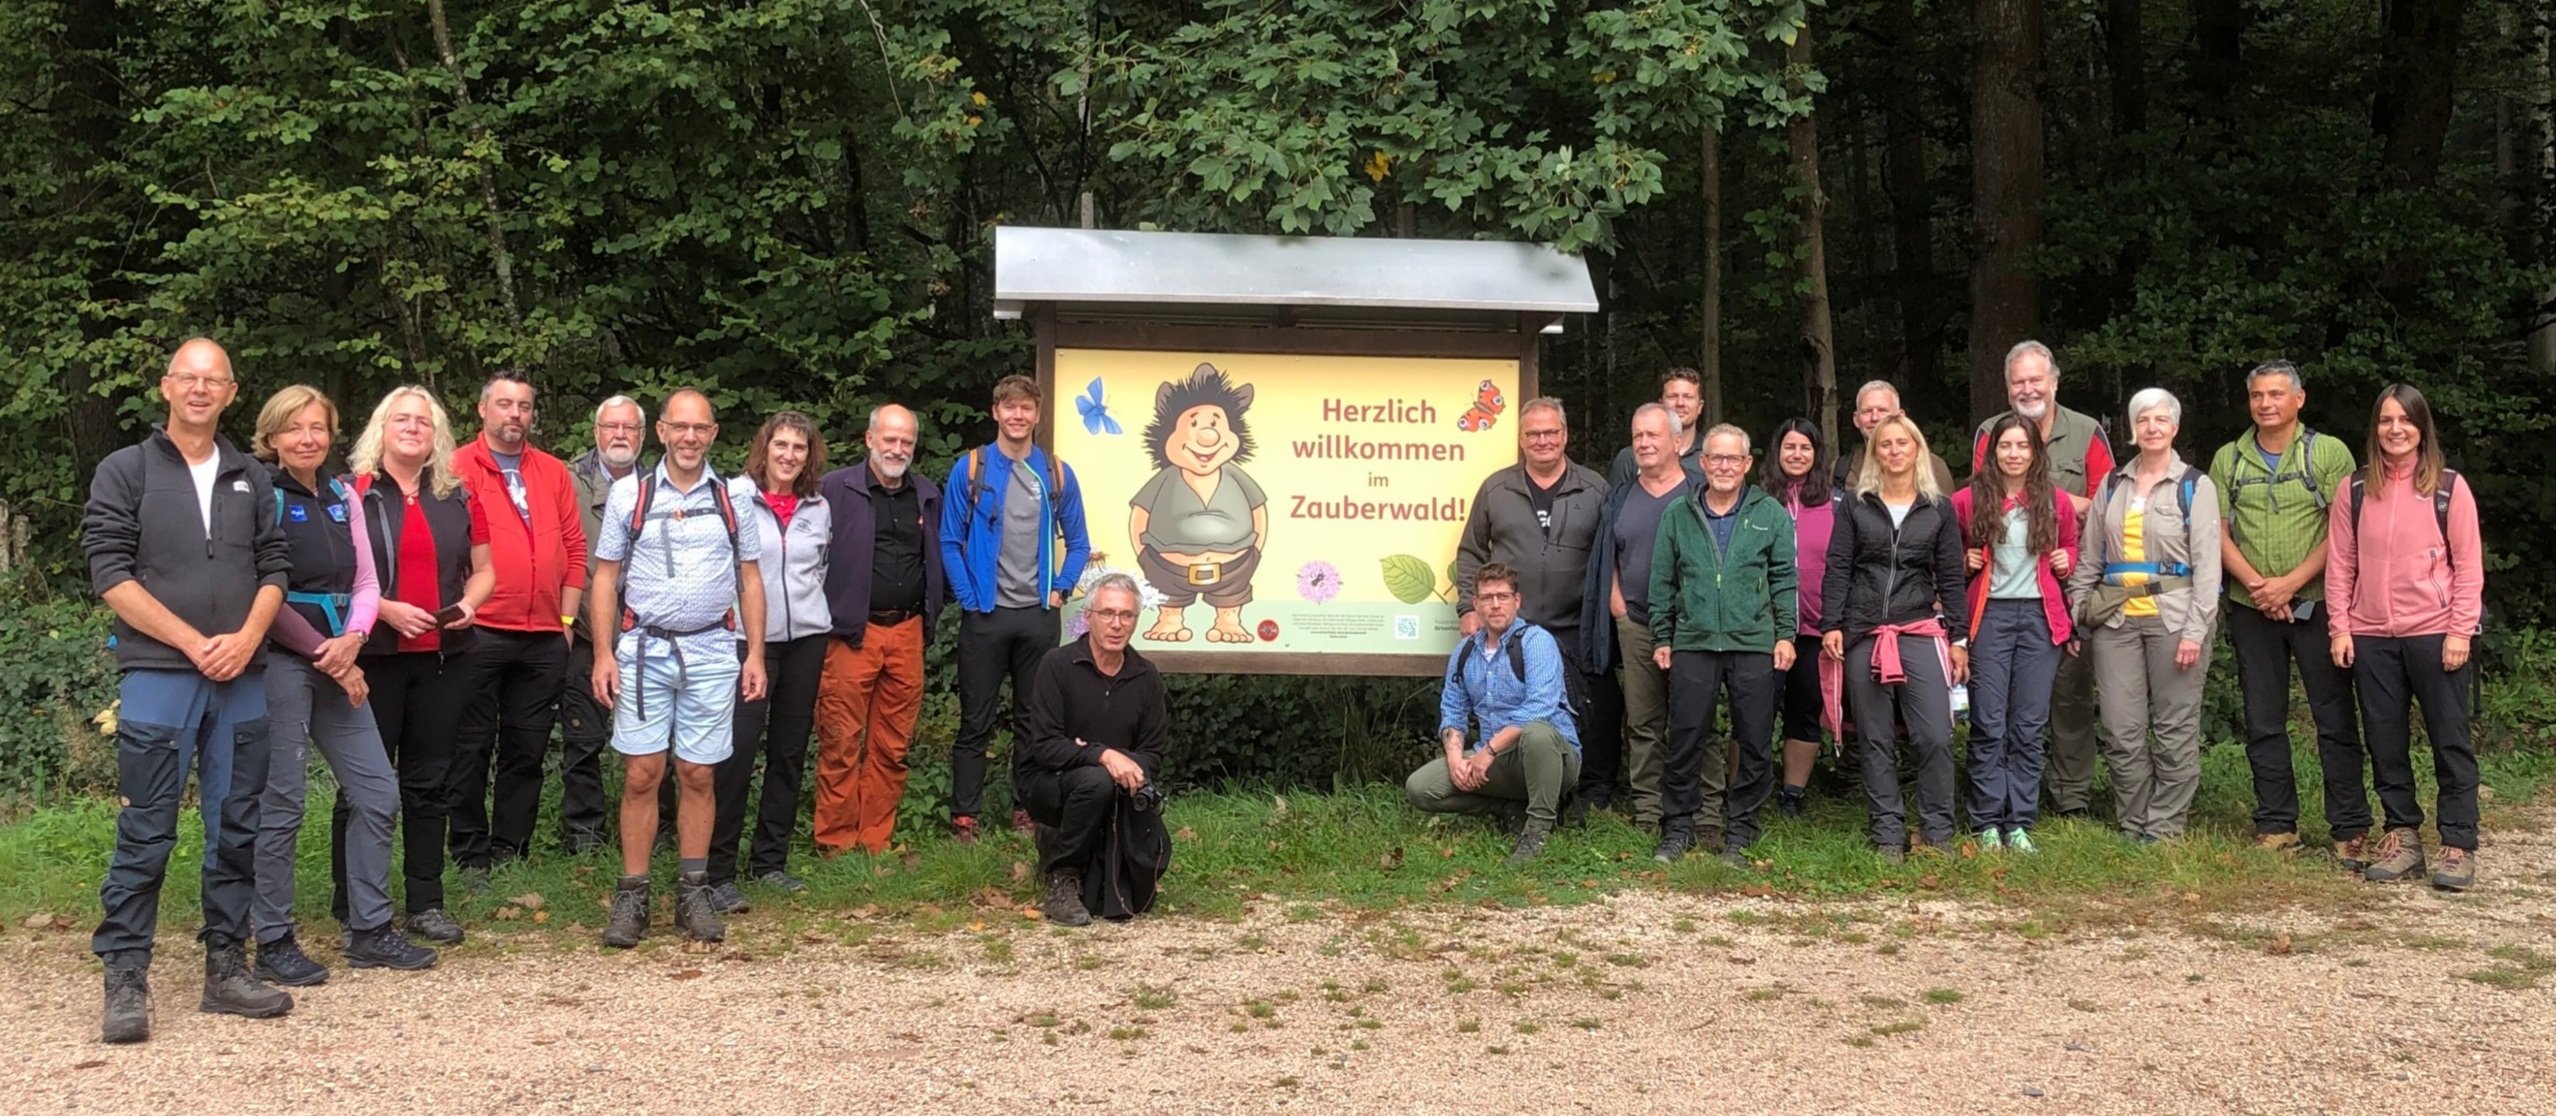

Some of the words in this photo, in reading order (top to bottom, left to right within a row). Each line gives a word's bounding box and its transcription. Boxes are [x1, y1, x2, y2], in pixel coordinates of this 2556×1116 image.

[1323, 398, 1436, 424] Herzlich
[1292, 434, 1465, 461] willkommen
[1368, 471, 1389, 487] im
[1290, 495, 1465, 521] Zauberwald!
